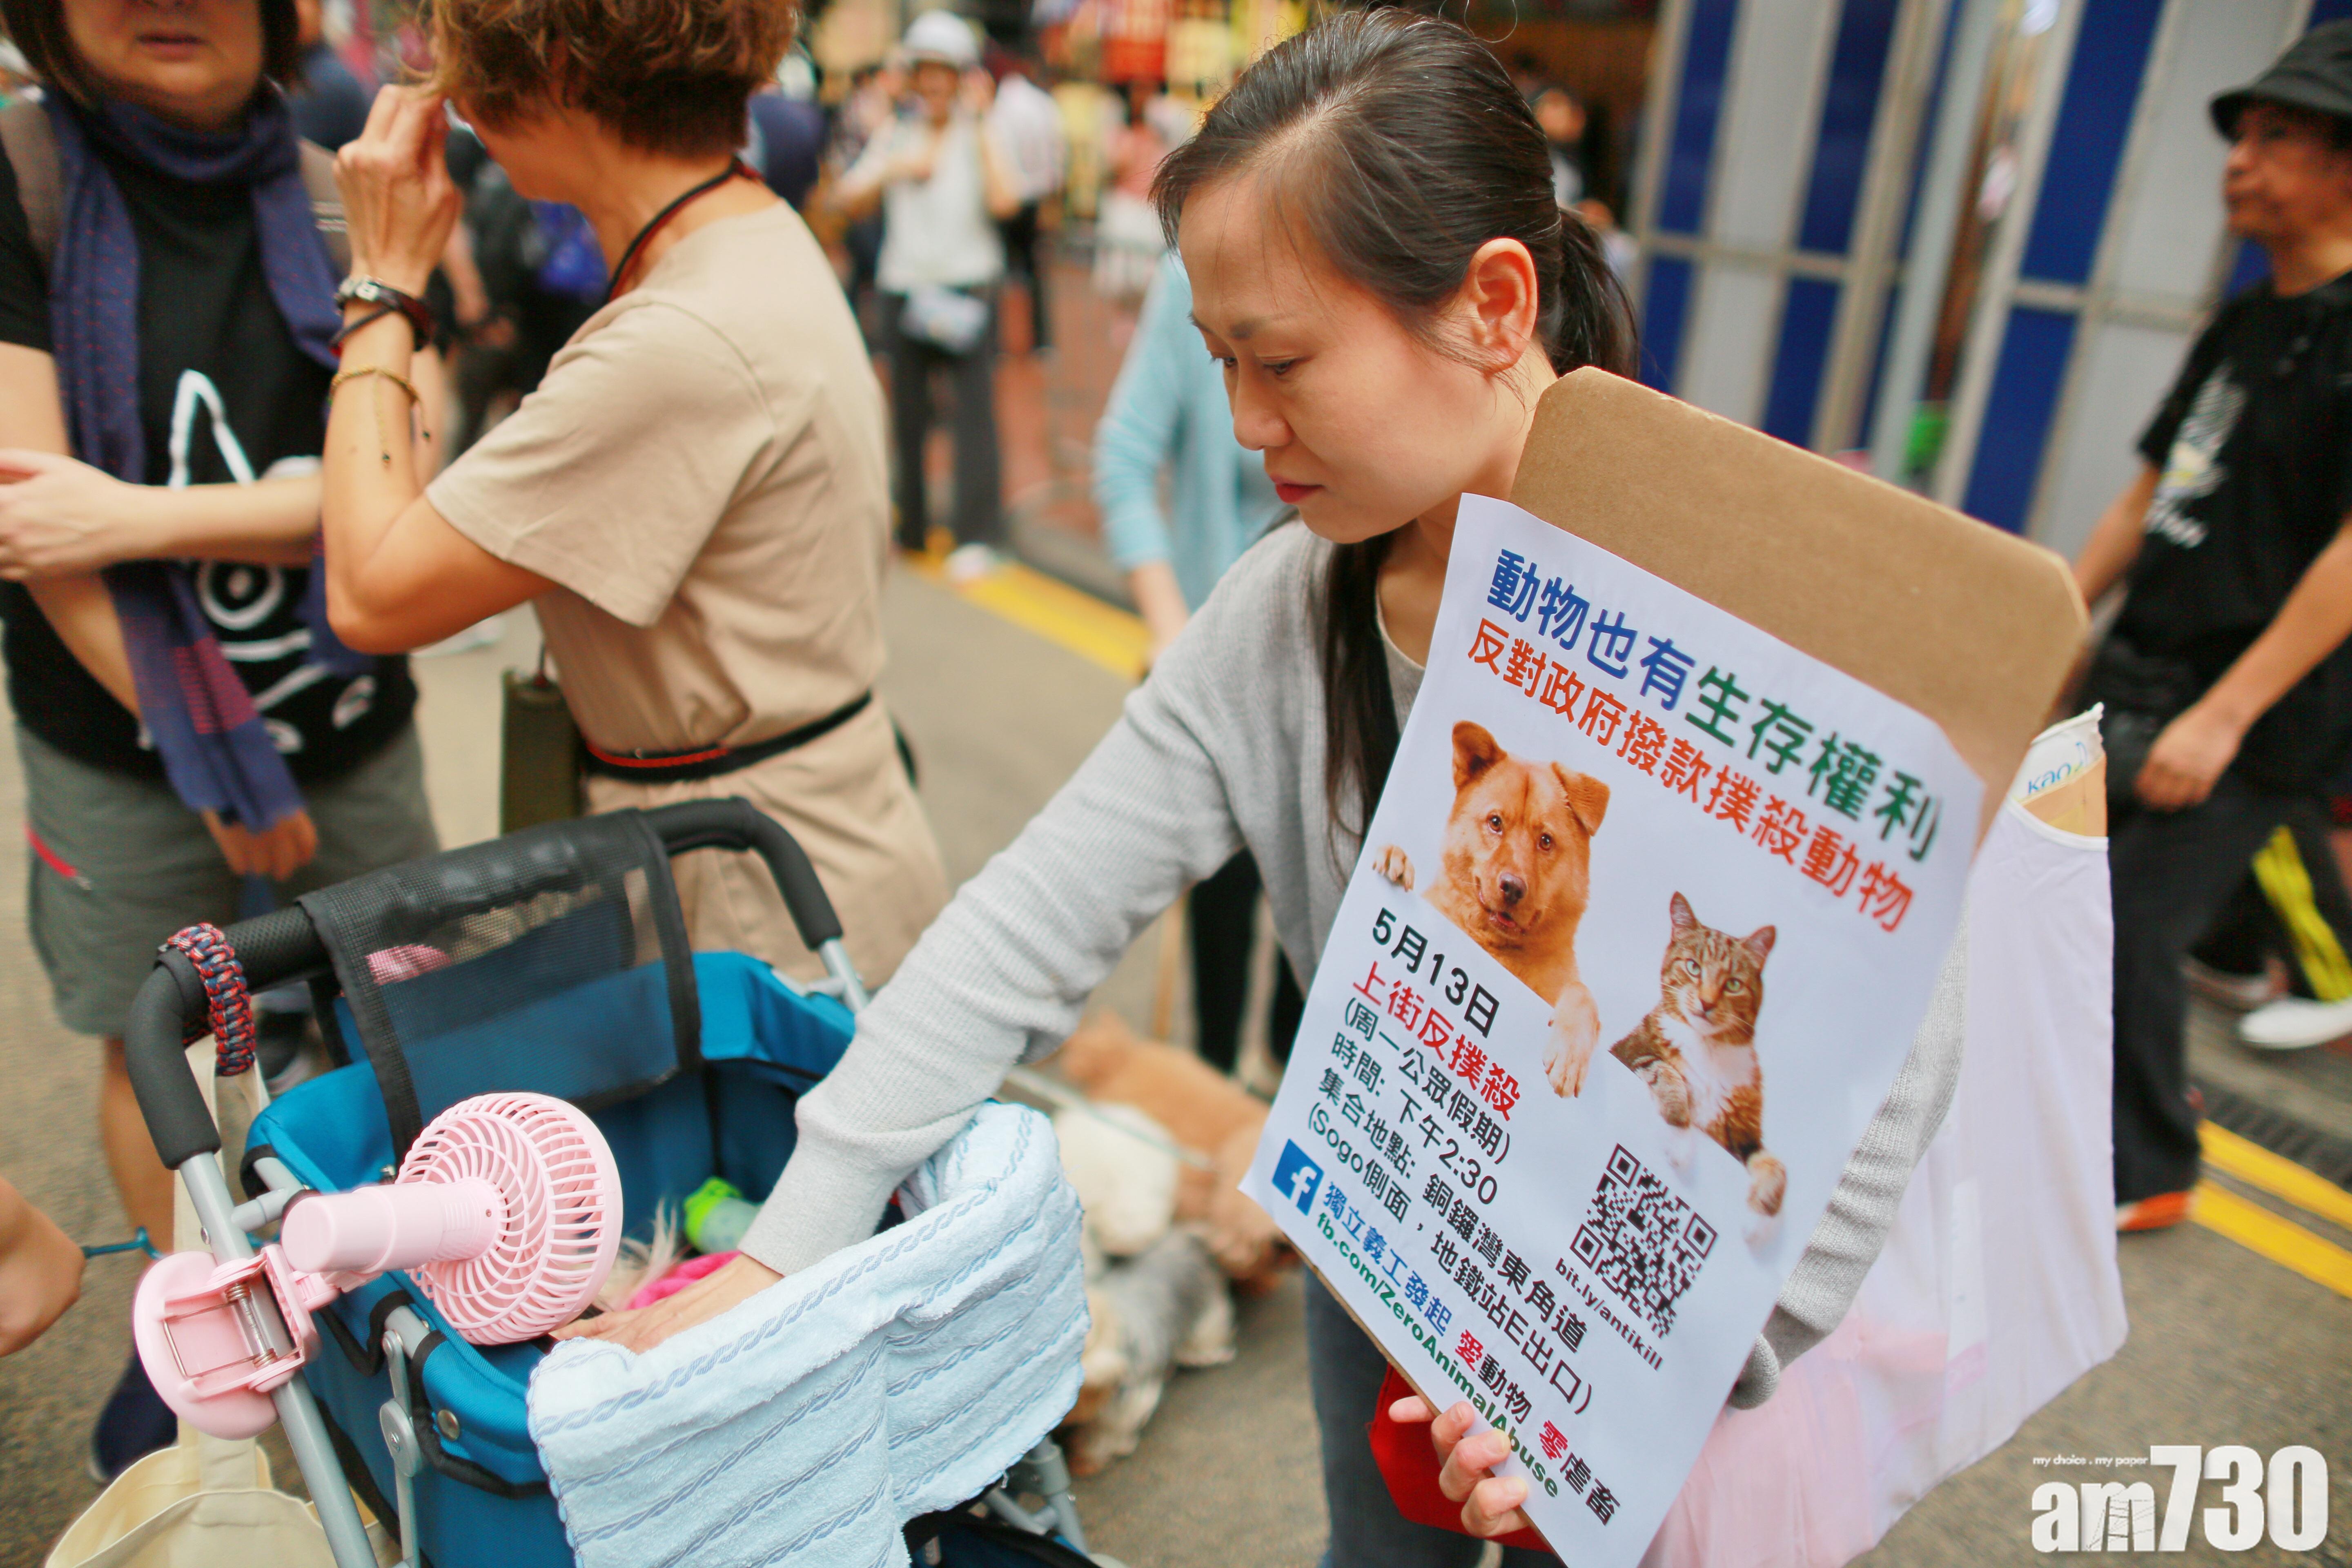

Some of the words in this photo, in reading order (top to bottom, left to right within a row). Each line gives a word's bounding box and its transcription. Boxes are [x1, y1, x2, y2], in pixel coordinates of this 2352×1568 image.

[1468, 618, 1917, 933] 反對政府撥款撲殺動物
[1487, 548, 1944, 862] 動物也有生存權利
[1353, 961, 1520, 1121] 上街反撲殺
[1372, 907, 1499, 1038] 5月13日
[1316, 1212, 1558, 1497] fb.com/ZeroAnimalAbuse
[1323, 1182, 1452, 1336] 獨立義工發起
[1455, 1330, 1532, 1424] 愛動物
[1423, 1174, 1587, 1353] 銅鑼灣東角道
[1555, 1258, 1663, 1372] bit.ly/antikill
